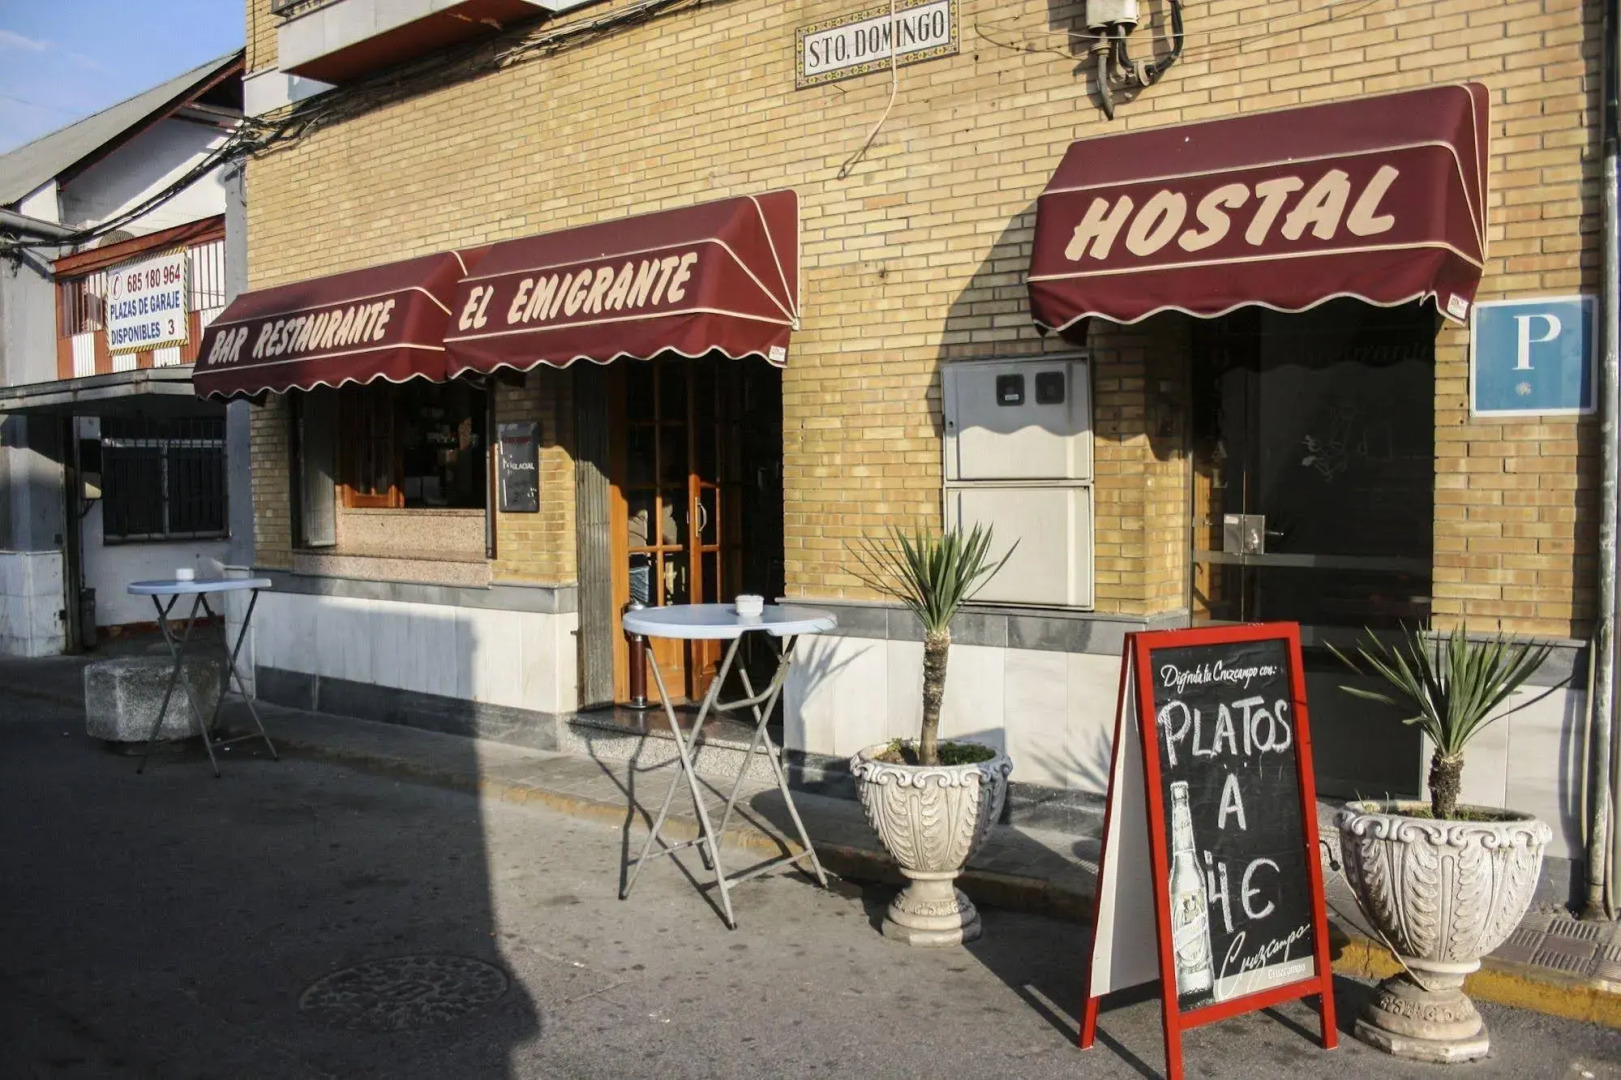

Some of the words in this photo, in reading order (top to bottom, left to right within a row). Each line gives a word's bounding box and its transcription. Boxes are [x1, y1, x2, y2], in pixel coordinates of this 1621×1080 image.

[809, 34, 851, 68] STO.
[854, 10, 945, 58] DOMINGO
[1064, 165, 1400, 262] HOSTAL
[110, 298, 137, 321] PLAZAS
[138, 296, 149, 316] DE
[150, 290, 181, 313] GARAJE
[127, 273, 142, 293] 685
[145, 268, 161, 289] 180
[163, 263, 181, 285] 964
[458, 285, 495, 331] EL
[507, 252, 698, 325] EMIGRANTE
[111, 321, 161, 346] DISPONIBLES
[167, 318, 175, 335] 3
[208, 326, 249, 365] BAR
[252, 299, 396, 359] RESTAURANTE
[1512, 313, 1563, 371] P
[1212, 660, 1258, 690] Cruzcampo
[1157, 695, 1292, 769] PLATOS
